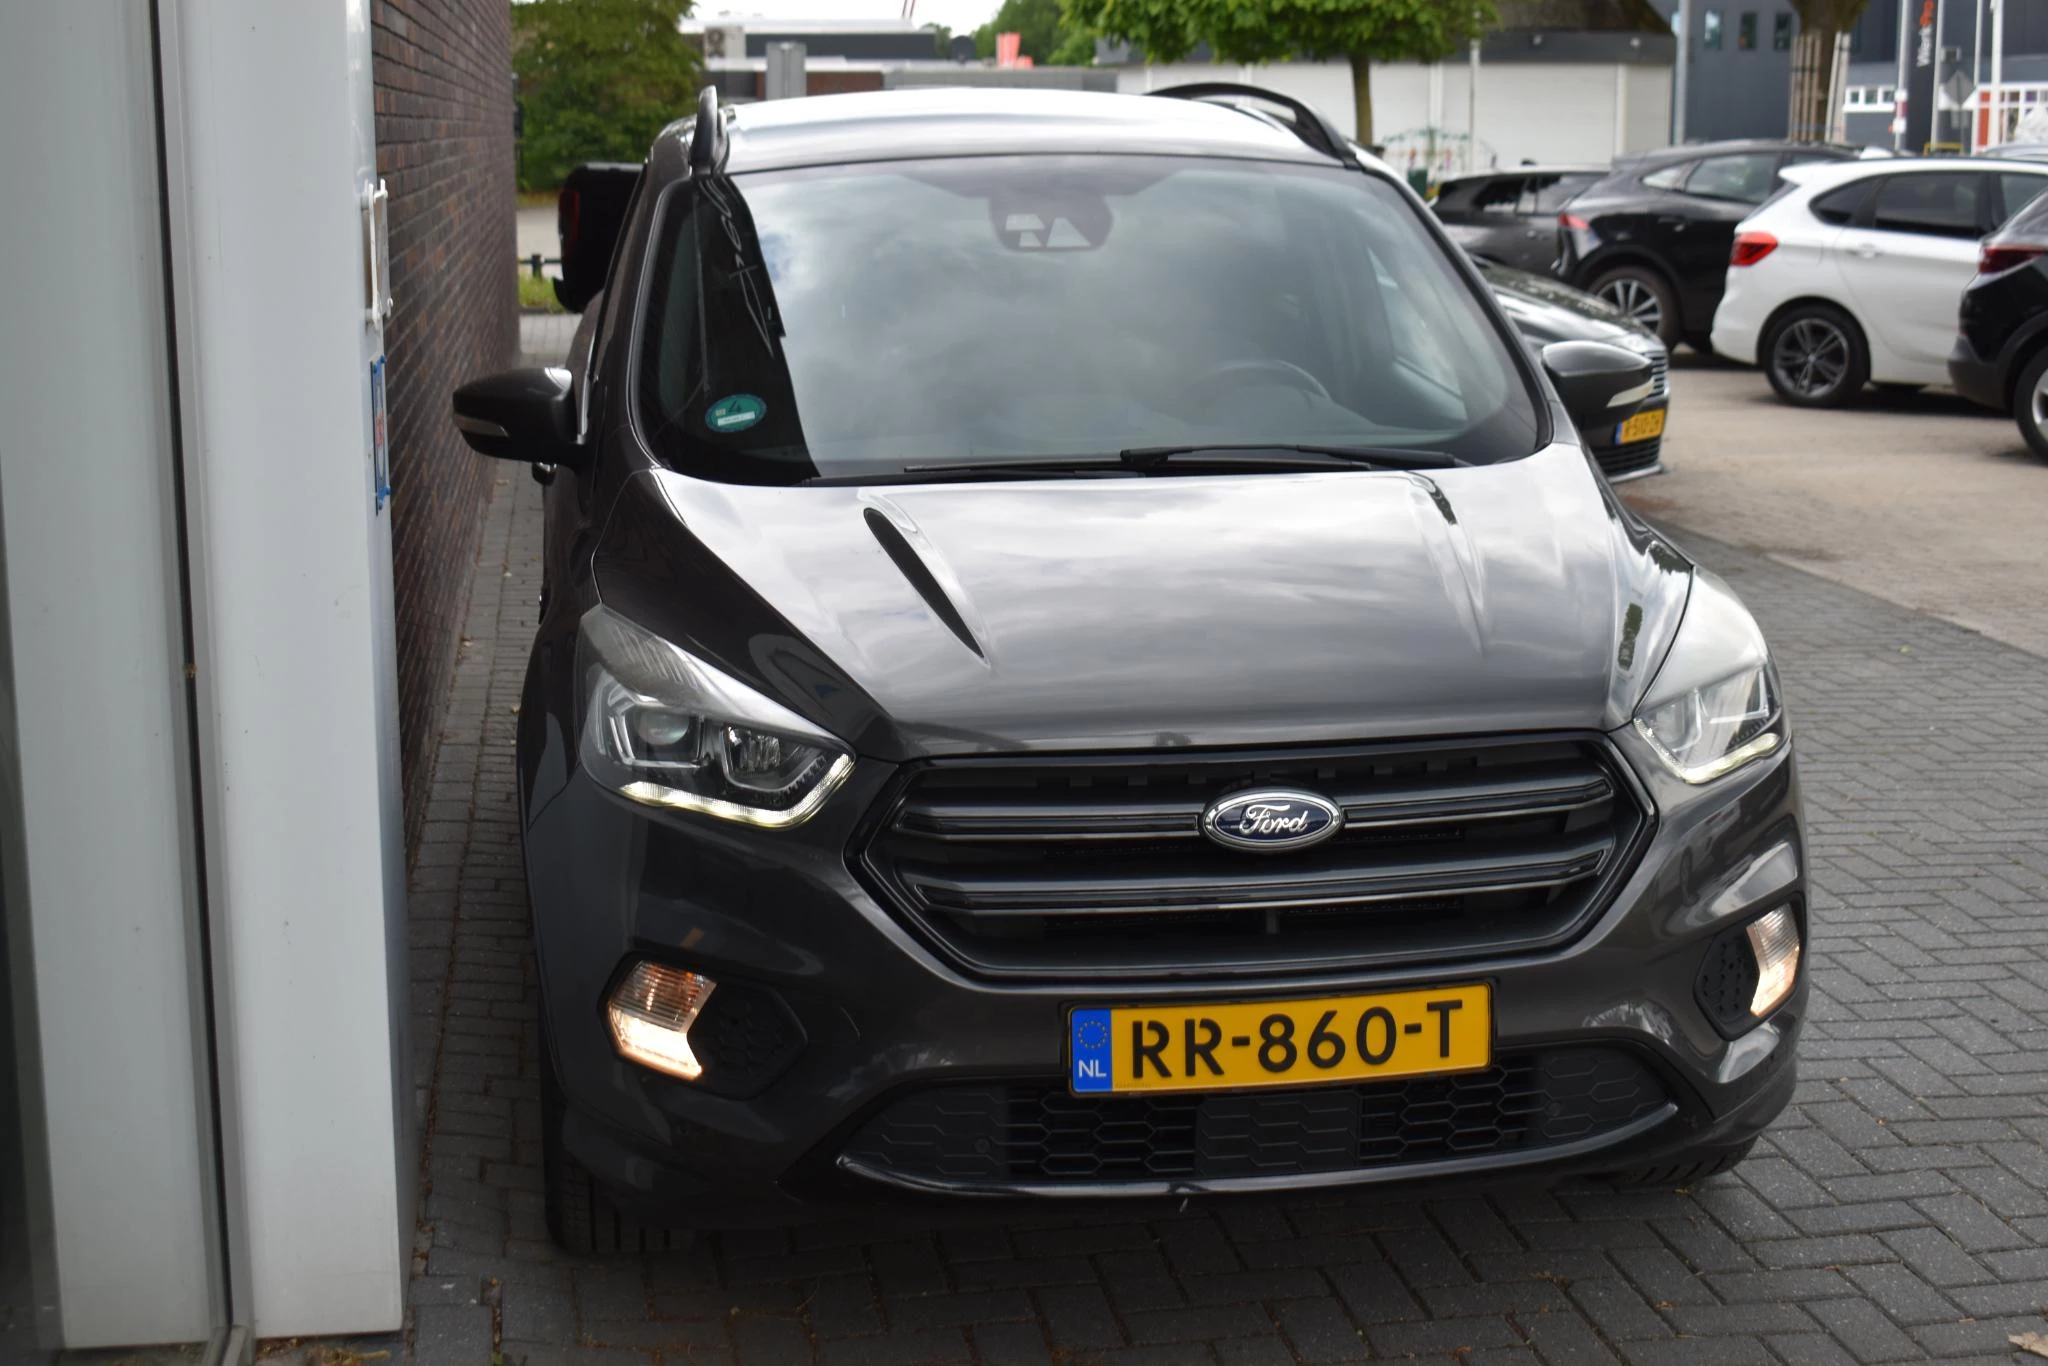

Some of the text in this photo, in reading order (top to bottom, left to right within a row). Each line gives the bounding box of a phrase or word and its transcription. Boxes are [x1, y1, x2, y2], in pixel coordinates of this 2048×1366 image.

[1239, 804, 1308, 834] Ford
[1132, 1000, 1462, 1079] RR-860-T
[1079, 1060, 1107, 1078] NL
